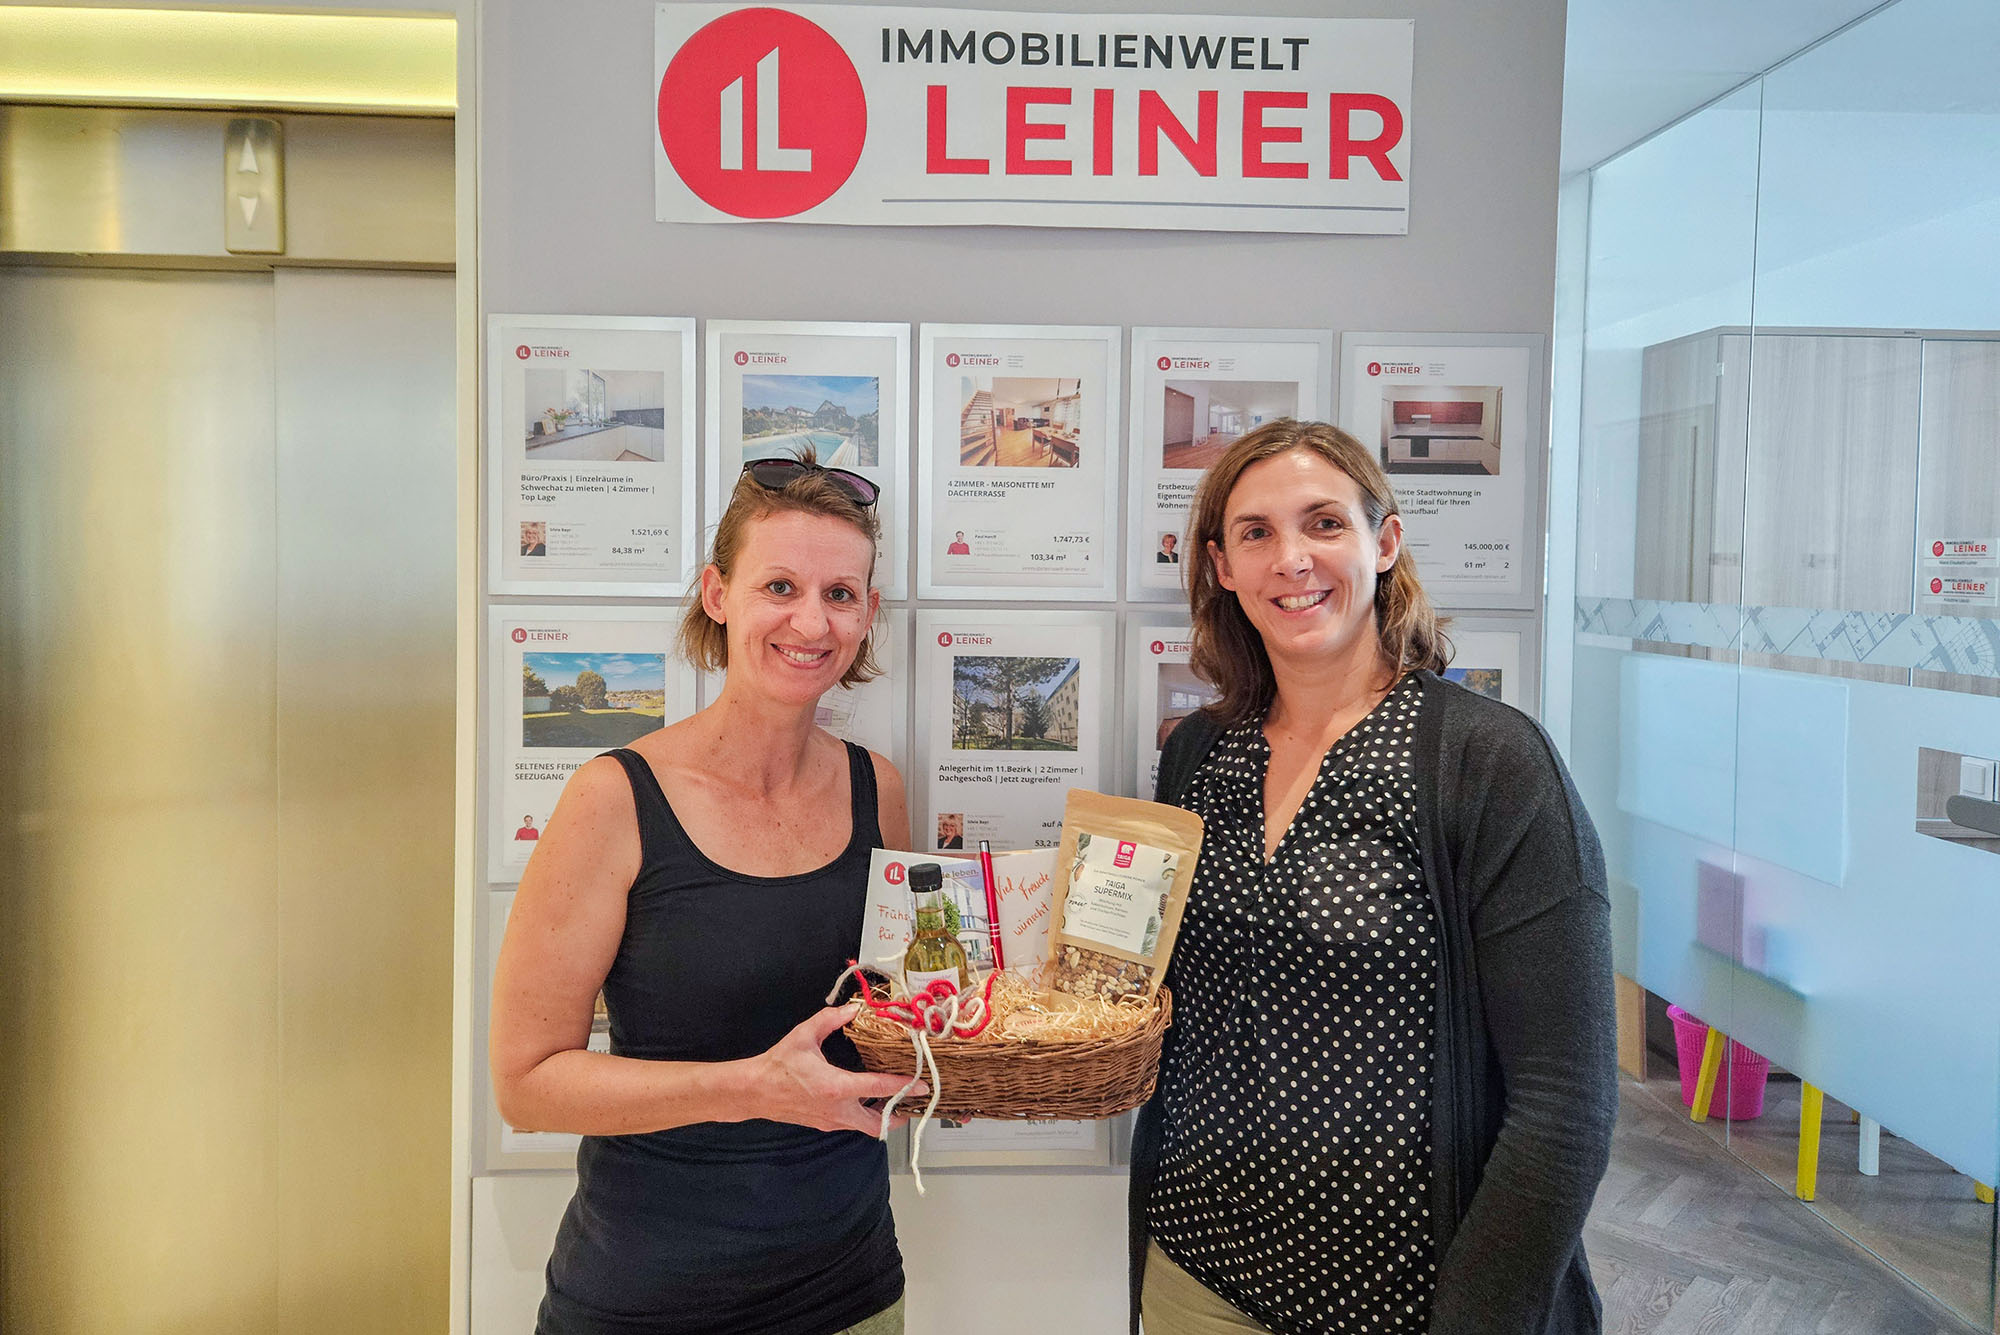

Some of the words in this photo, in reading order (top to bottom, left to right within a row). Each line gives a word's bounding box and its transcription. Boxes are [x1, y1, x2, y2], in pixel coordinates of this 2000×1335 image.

[881, 27, 1310, 71] IMMOBILIENWELT
[926, 84, 1405, 182] LEINER
[534, 350, 570, 358] LEINER
[752, 356, 787, 364] LEINER
[963, 358, 999, 366] LEINER
[1174, 361, 1210, 369] LEINER
[1384, 366, 1421, 374] LEINER
[520, 474, 568, 482] Büro/Praxis
[575, 475, 624, 483] Einzelräume
[625, 475, 634, 483] in
[520, 484, 563, 492] Schwechat
[991, 481, 1039, 489] MAISONETTE
[947, 490, 1006, 498] DACHTERRASSE
[1157, 493, 1193, 501] Eigentum
[1416, 489, 1472, 498] Stadtwohnung
[521, 494, 535, 502] Top
[537, 494, 556, 502] Lage
[631, 528, 662, 537] 1.521,69
[1053, 536, 1083, 544] 1.747,73
[612, 547, 632, 555] 84,38
[1464, 544, 1503, 552] 145.000,00
[1953, 544, 1987, 552] LEINER
[1951, 582, 1985, 591] LEINER
[531, 632, 569, 641] LEINER
[956, 636, 992, 645] LEINER
[1167, 645, 1191, 653] LEIN
[939, 764, 981, 773] Anlegerhit
[996, 765, 1032, 773] 11.Bezirk
[1046, 766, 1078, 774] Zimmer
[515, 773, 564, 781] SEEZUGANG
[939, 775, 993, 783] Dachgeschoß
[999, 775, 1019, 784] Jetzt
[1020, 776, 1061, 784] zugreifen!
[952, 867, 979, 878] leben.
[995, 875, 1014, 902] Viel
[1019, 872, 1050, 901] Freude
[1105, 879, 1126, 890] TAIGA
[1094, 886, 1133, 901] SUPERMIX
[877, 904, 911, 920] Frühs
[879, 926, 895, 941] für
